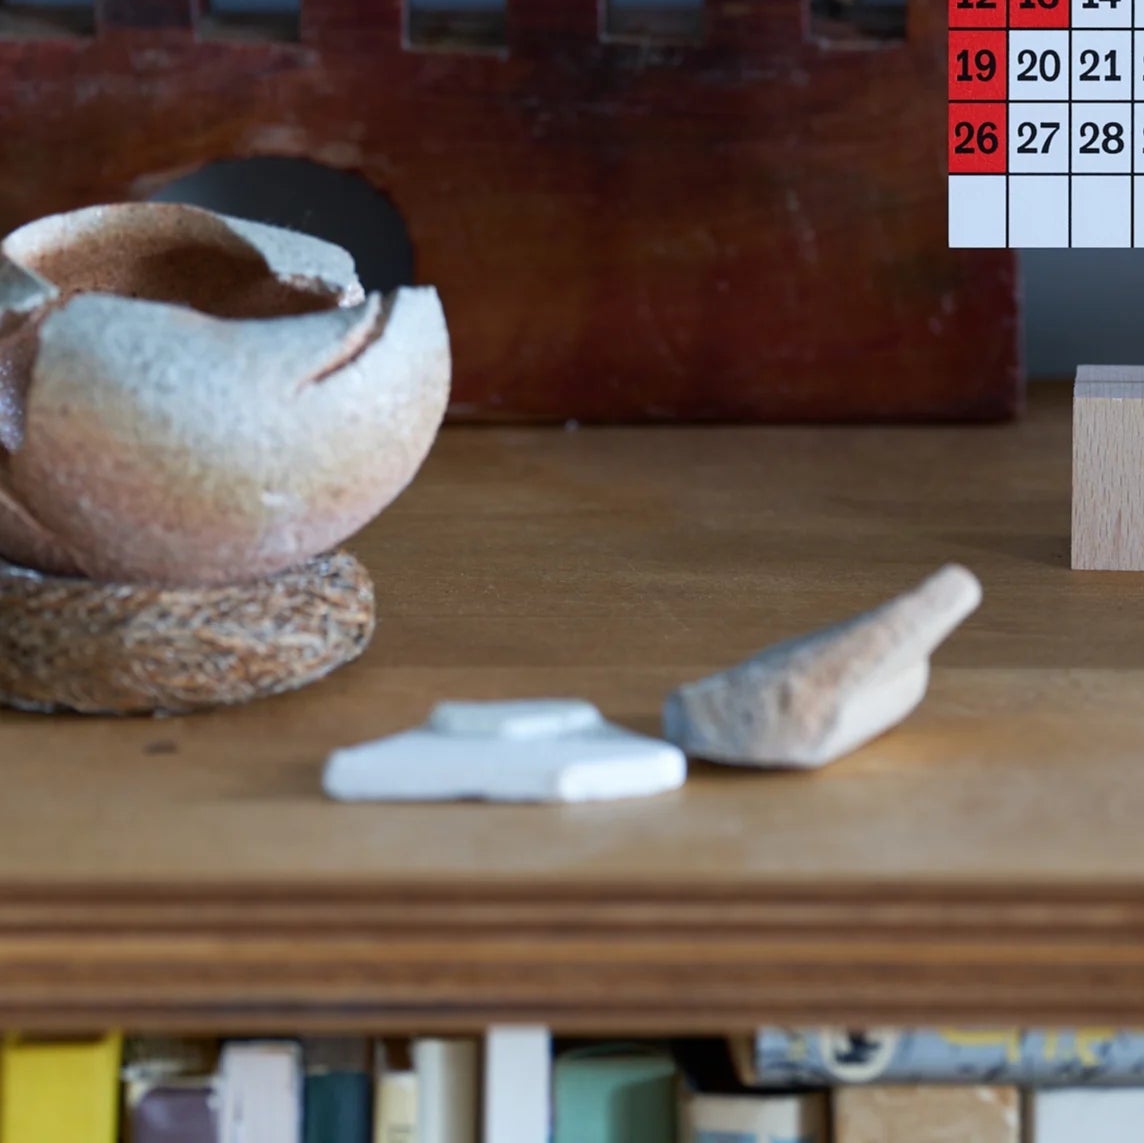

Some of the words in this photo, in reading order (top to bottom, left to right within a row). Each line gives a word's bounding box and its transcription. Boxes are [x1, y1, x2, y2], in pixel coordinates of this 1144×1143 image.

[956, 49, 997, 82] 19
[1017, 49, 1061, 82] 20
[1079, 49, 1121, 82] 21
[954, 121, 999, 155] 26
[1017, 121, 1060, 154] 27
[1079, 121, 1125, 154] 28
